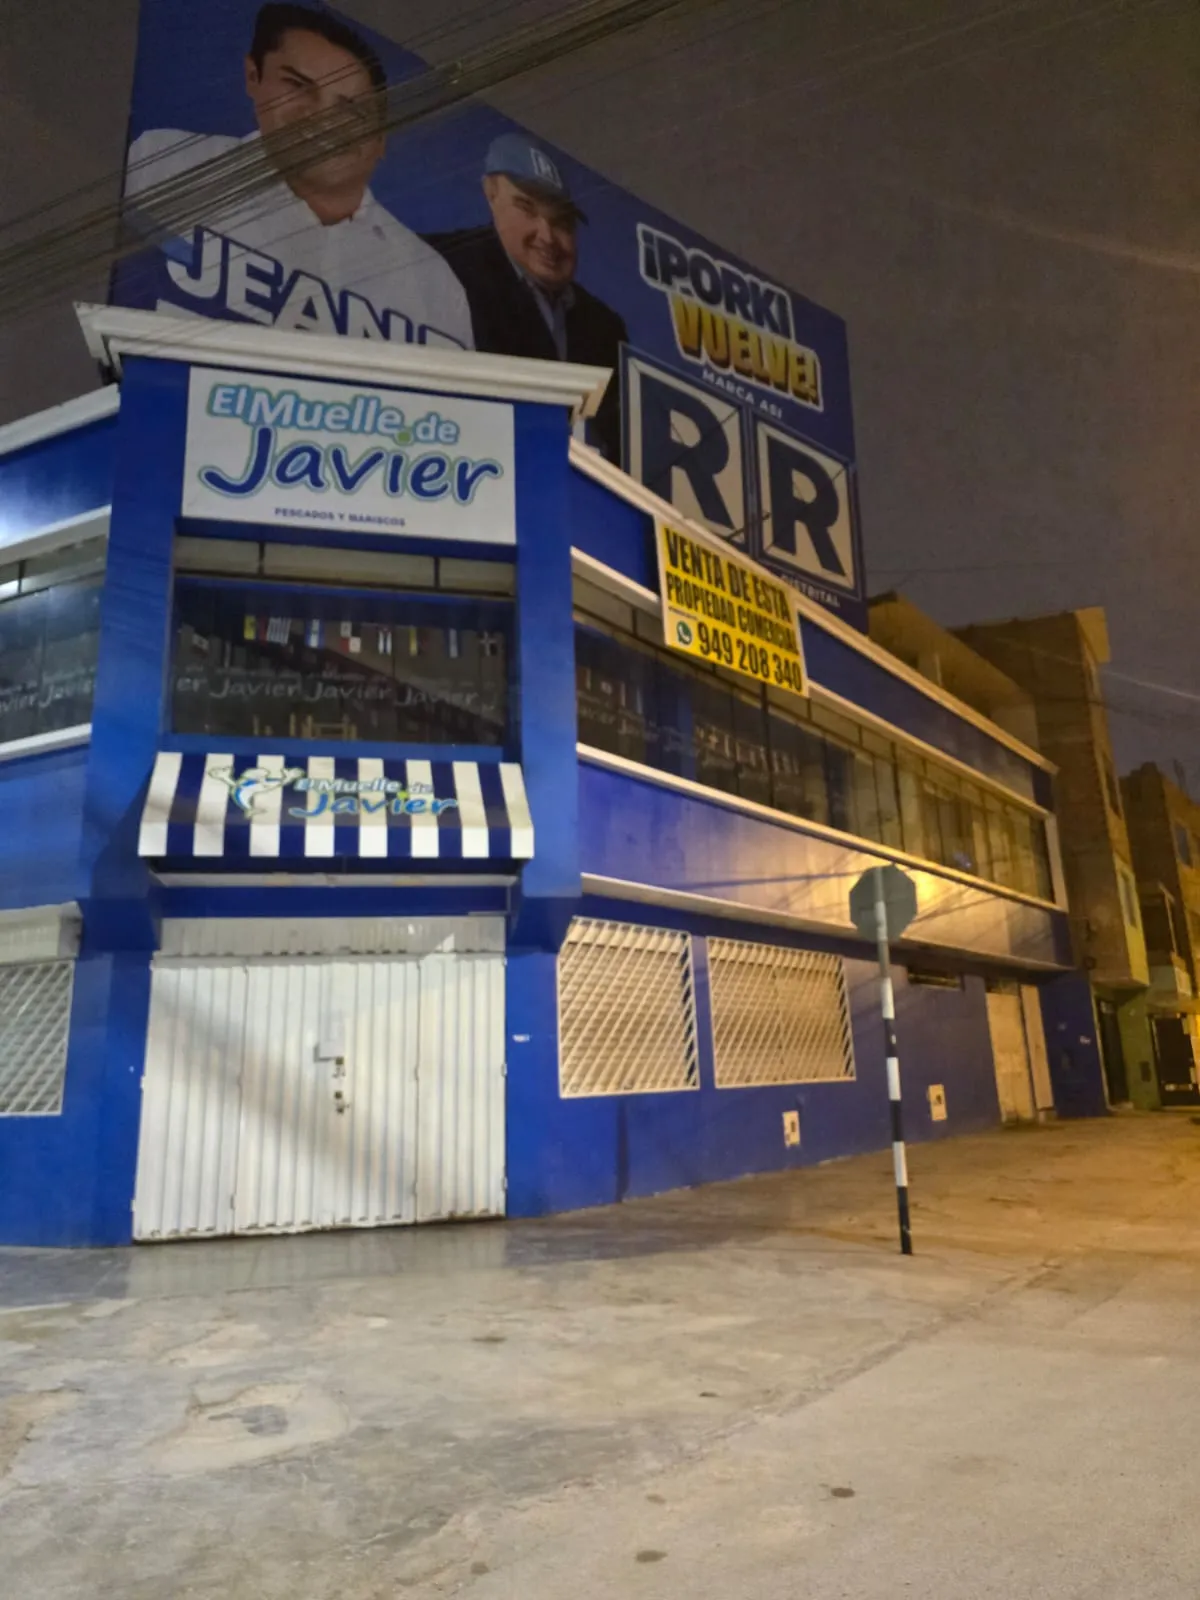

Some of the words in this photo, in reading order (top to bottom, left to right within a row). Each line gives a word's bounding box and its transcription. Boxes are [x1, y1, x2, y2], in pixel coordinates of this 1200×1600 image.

[669, 292, 823, 412] VUELVE!
[206, 383, 248, 417] El
[245, 389, 405, 437] Muelle
[413, 411, 460, 445] de
[702, 368, 755, 405] MARCA
[199, 425, 504, 505] Javier
[640, 373, 735, 530] R
[274, 506, 336, 521] PESCADOS
[338, 513, 346, 521] Y
[347, 513, 406, 528] MARISCOS
[767, 435, 847, 577] R
[664, 527, 726, 593] VENTA
[727, 561, 753, 603] DE
[752, 573, 793, 625] ESTA
[665, 570, 737, 629] PROPIEDAD
[697, 621, 734, 665] 949
[736, 638, 770, 679] 208
[772, 653, 803, 693] 340
[287, 793, 458, 818] Javier
[317, 778, 402, 794] Muelle
